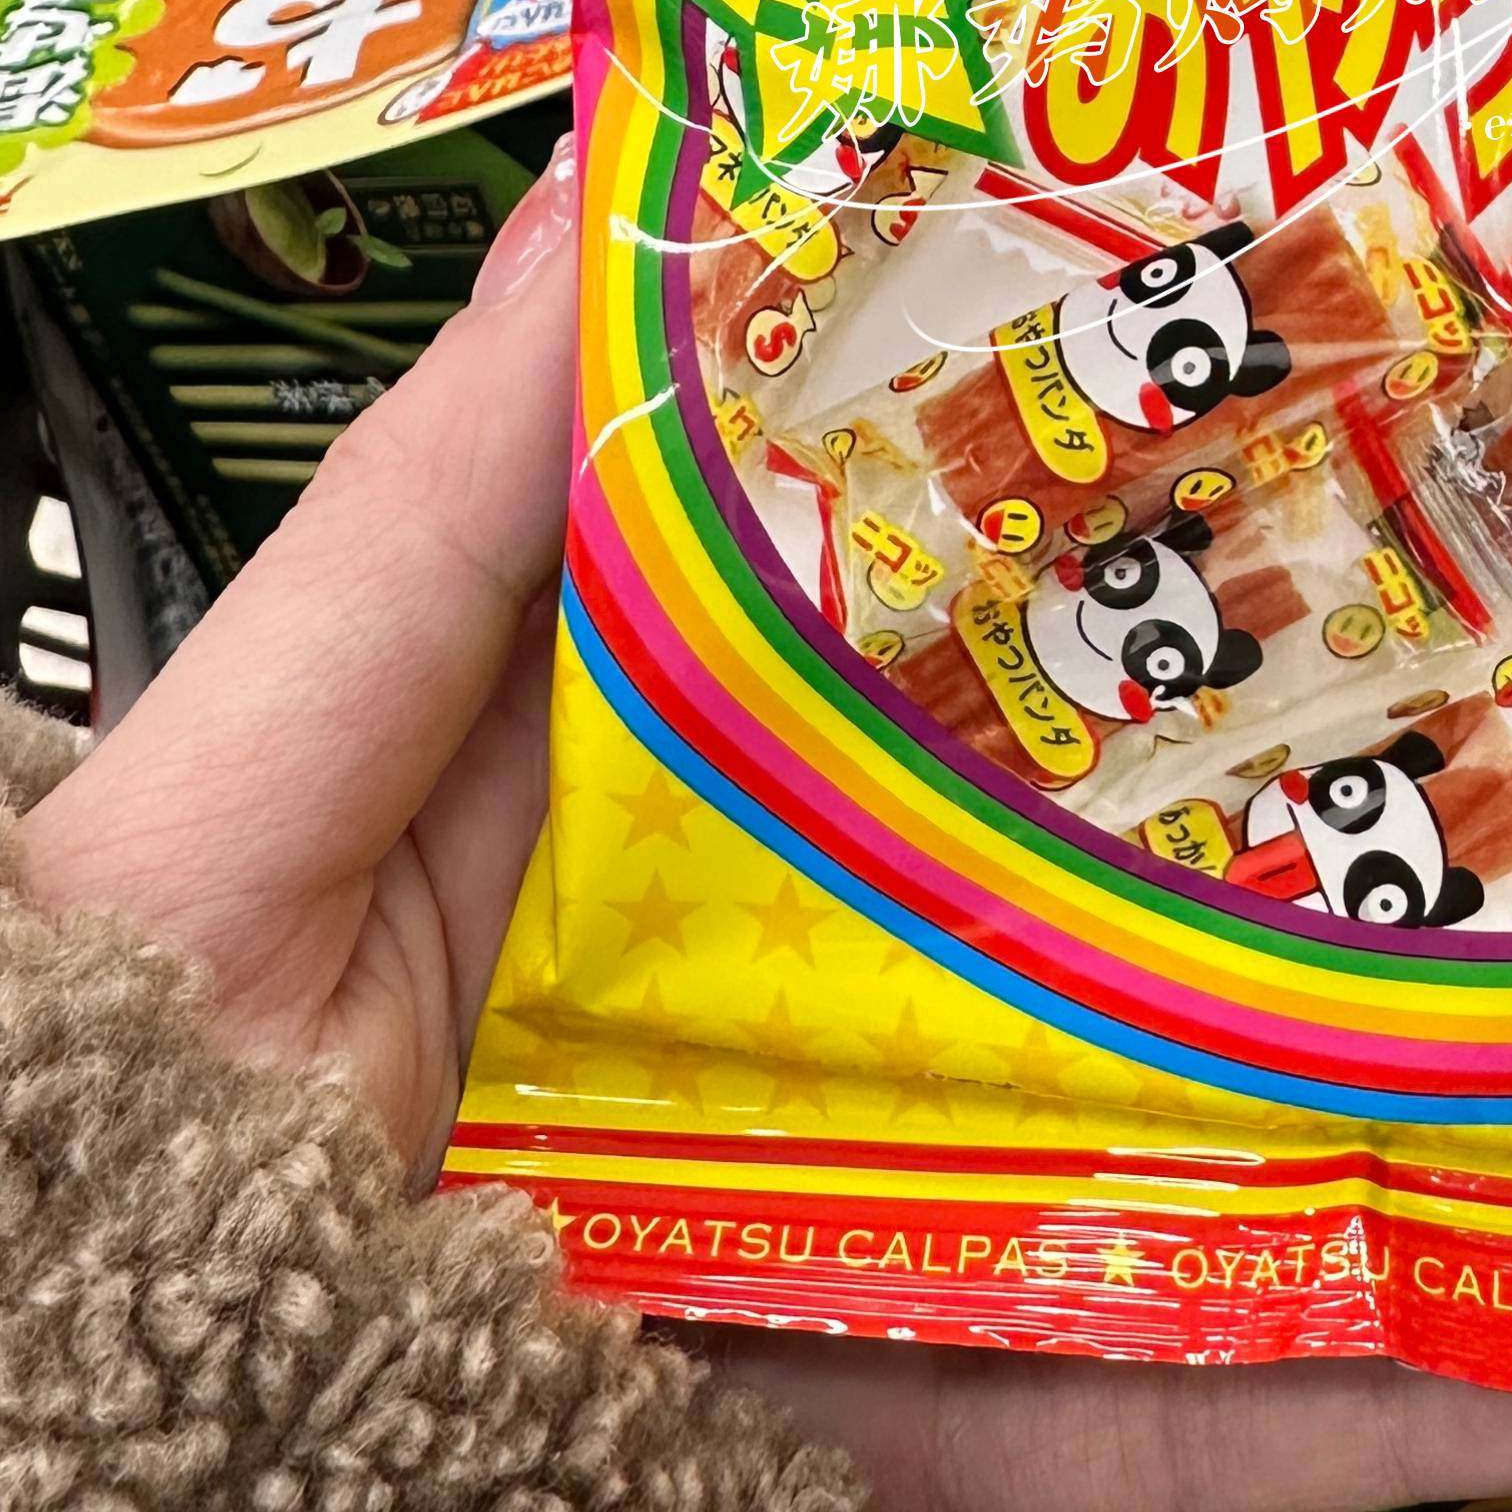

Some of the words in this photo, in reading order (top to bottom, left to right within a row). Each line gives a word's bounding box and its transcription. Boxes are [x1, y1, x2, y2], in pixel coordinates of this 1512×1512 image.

[970, 597, 1084, 749] おやつパンダ
[582, 1210, 814, 1265] OYATSU
[837, 1228, 1070, 1281] CALPAS
[1171, 1239, 1392, 1291] OYATSU
